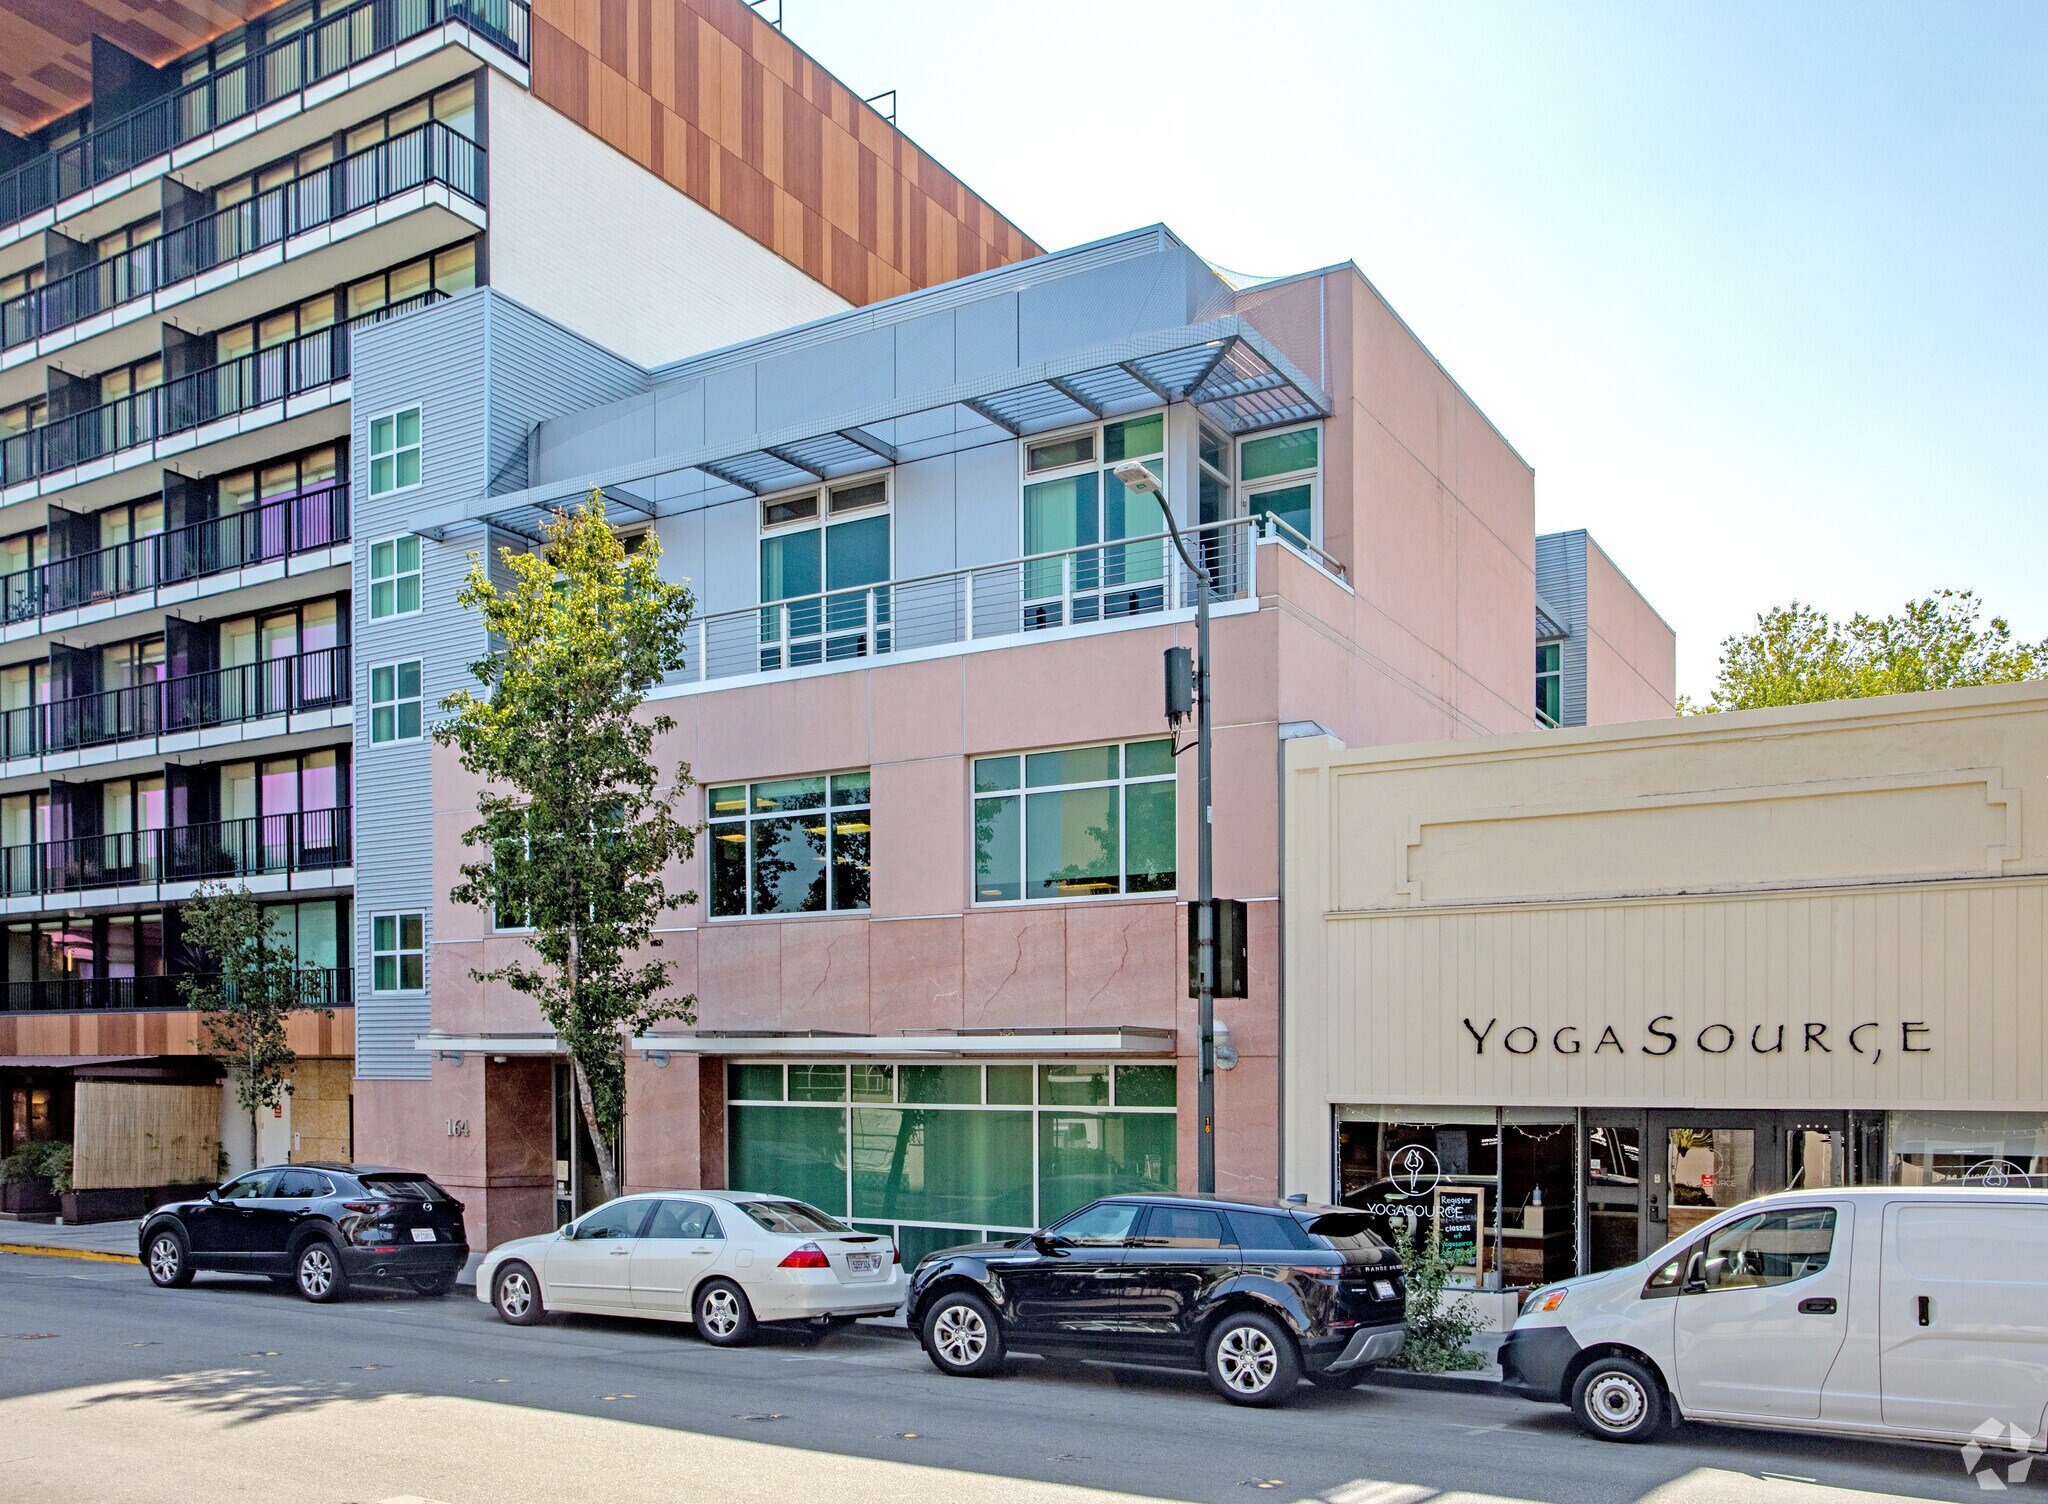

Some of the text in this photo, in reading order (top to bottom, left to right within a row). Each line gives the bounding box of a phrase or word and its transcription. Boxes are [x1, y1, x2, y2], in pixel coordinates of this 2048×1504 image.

[446, 1118, 470, 1137] 164
[1441, 1196, 1472, 1206] Register
[1367, 1203, 1464, 1218] YOGASOURCE
[1445, 1224, 1471, 1232] classes
